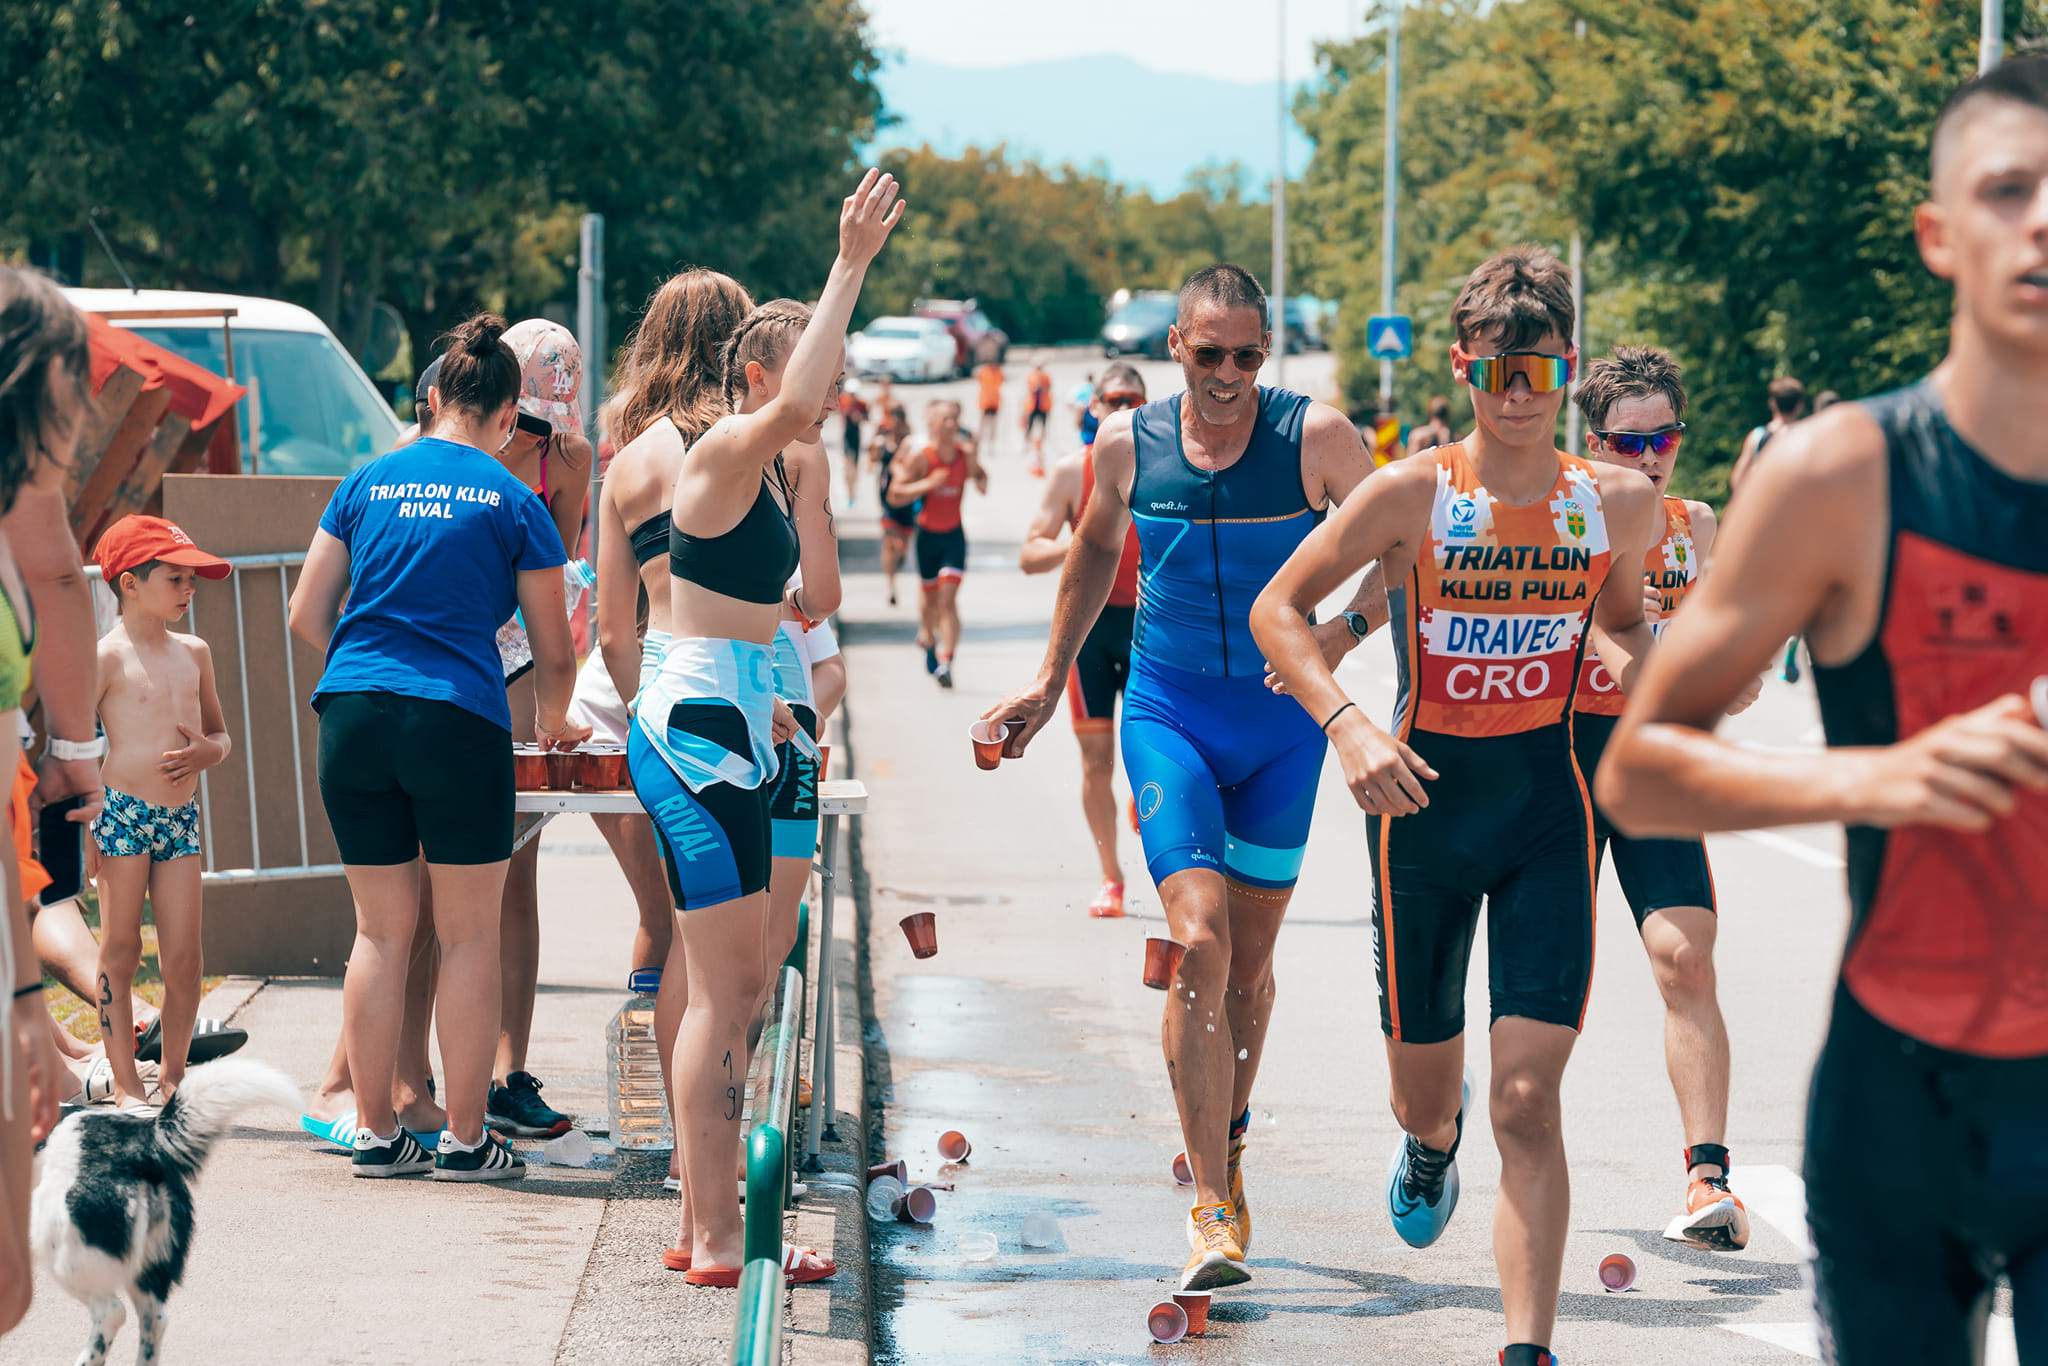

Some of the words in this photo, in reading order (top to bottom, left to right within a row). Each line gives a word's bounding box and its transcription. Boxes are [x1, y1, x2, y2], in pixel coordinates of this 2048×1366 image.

[552, 358, 574, 394] LA
[369, 483, 452, 502] TRIATLON
[455, 486, 501, 507] KLUB
[1150, 500, 1189, 511] quest.hr
[398, 501, 453, 519] RIVAL
[1443, 545, 1591, 571] TRIATLON
[1440, 579, 1512, 601] KLUB
[1521, 580, 1587, 601] PULA
[1446, 616, 1567, 655] DRAVEC
[1446, 660, 1551, 700] CRO
[654, 794, 721, 862] RIVAL
